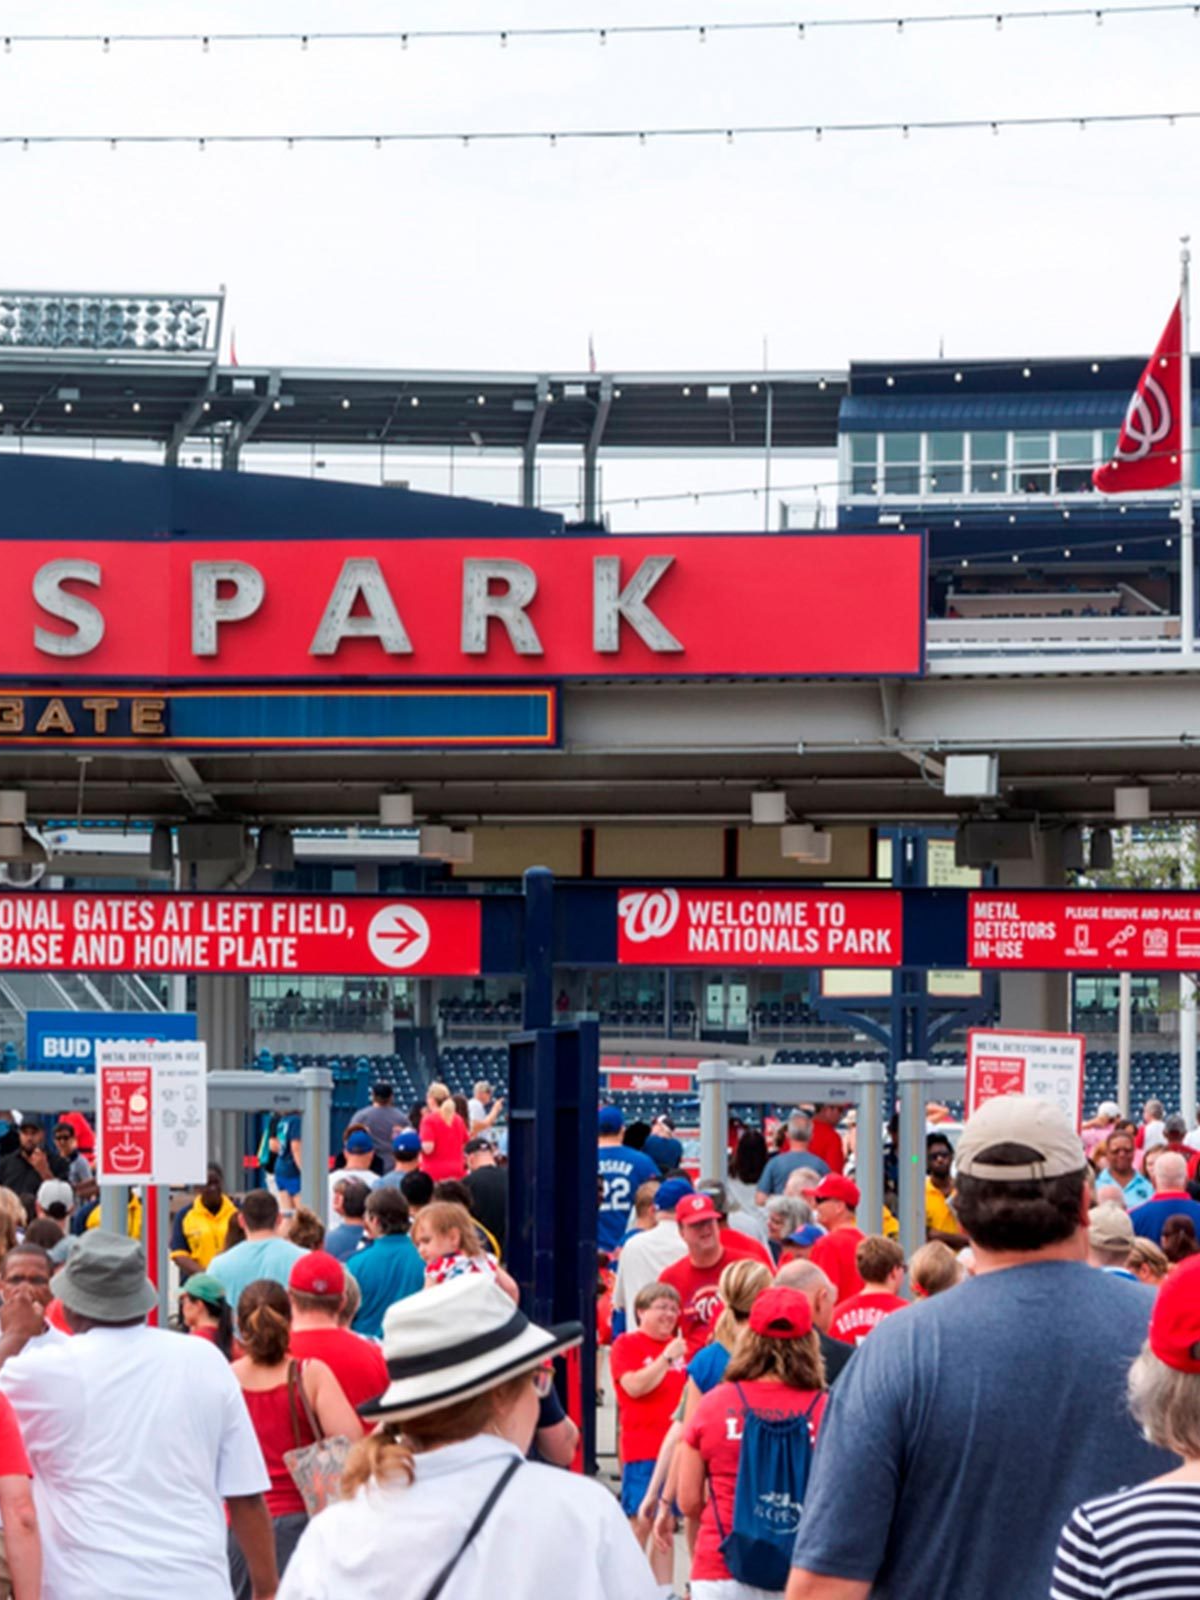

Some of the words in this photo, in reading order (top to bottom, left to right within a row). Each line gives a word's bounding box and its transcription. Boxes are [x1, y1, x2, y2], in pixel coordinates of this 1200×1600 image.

[191, 555, 685, 656] PARK
[72, 900, 155, 931] GATES
[162, 901, 194, 931] AT
[202, 902, 265, 933] LEFT
[271, 903, 355, 939] FIELD,
[687, 901, 808, 926] WELCOME
[815, 902, 846, 927] TO
[973, 902, 1021, 919] METAL
[1065, 906, 1099, 919] PLEASE
[1101, 907, 1139, 920] REMOVE
[1141, 908, 1160, 920] AND
[1161, 908, 1191, 920] PLACE
[687, 928, 820, 953] NATIONALS
[827, 929, 893, 954] PARK
[973, 921, 1057, 940] DETECTORS
[71, 935, 125, 965] AND
[134, 935, 209, 967] HOME
[218, 936, 298, 968] PLATE
[973, 941, 1024, 959] IN-USE
[42, 1037, 92, 1058] BUD
